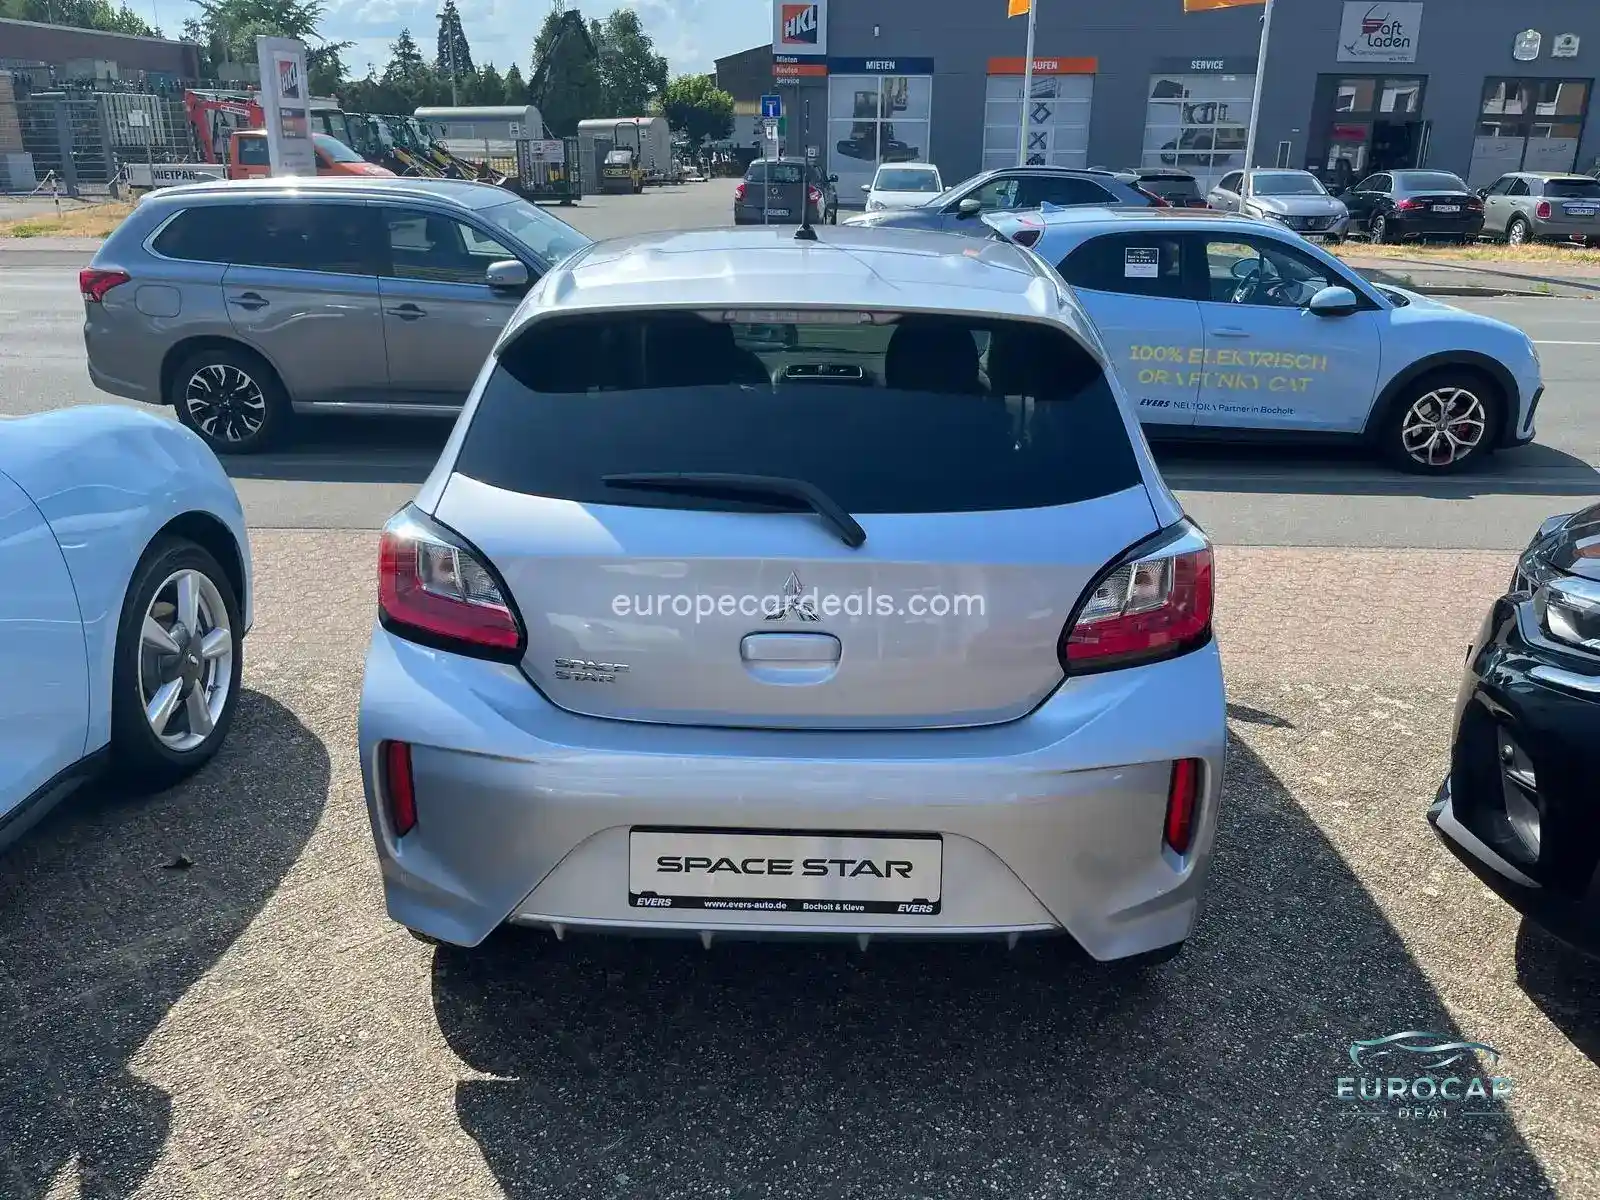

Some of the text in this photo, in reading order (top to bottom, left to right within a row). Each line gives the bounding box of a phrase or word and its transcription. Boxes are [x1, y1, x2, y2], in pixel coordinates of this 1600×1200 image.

[784, 5, 817, 37] HKL
[865, 60, 896, 70] MIETEN
[1028, 60, 1058, 70] AUFEN
[1190, 60, 1224, 70] SERVICE
[776, 77, 800, 85] Service
[1139, 398, 1171, 408] EVERS
[1218, 404, 1250, 413] Partner
[656, 856, 914, 879] SPACE STAR
[636, 897, 672, 907] EVERS
[704, 900, 787, 910] www.evers-auto.de
[803, 902, 865, 912] Bocholt & Kleve
[897, 904, 934, 913] EVERS
